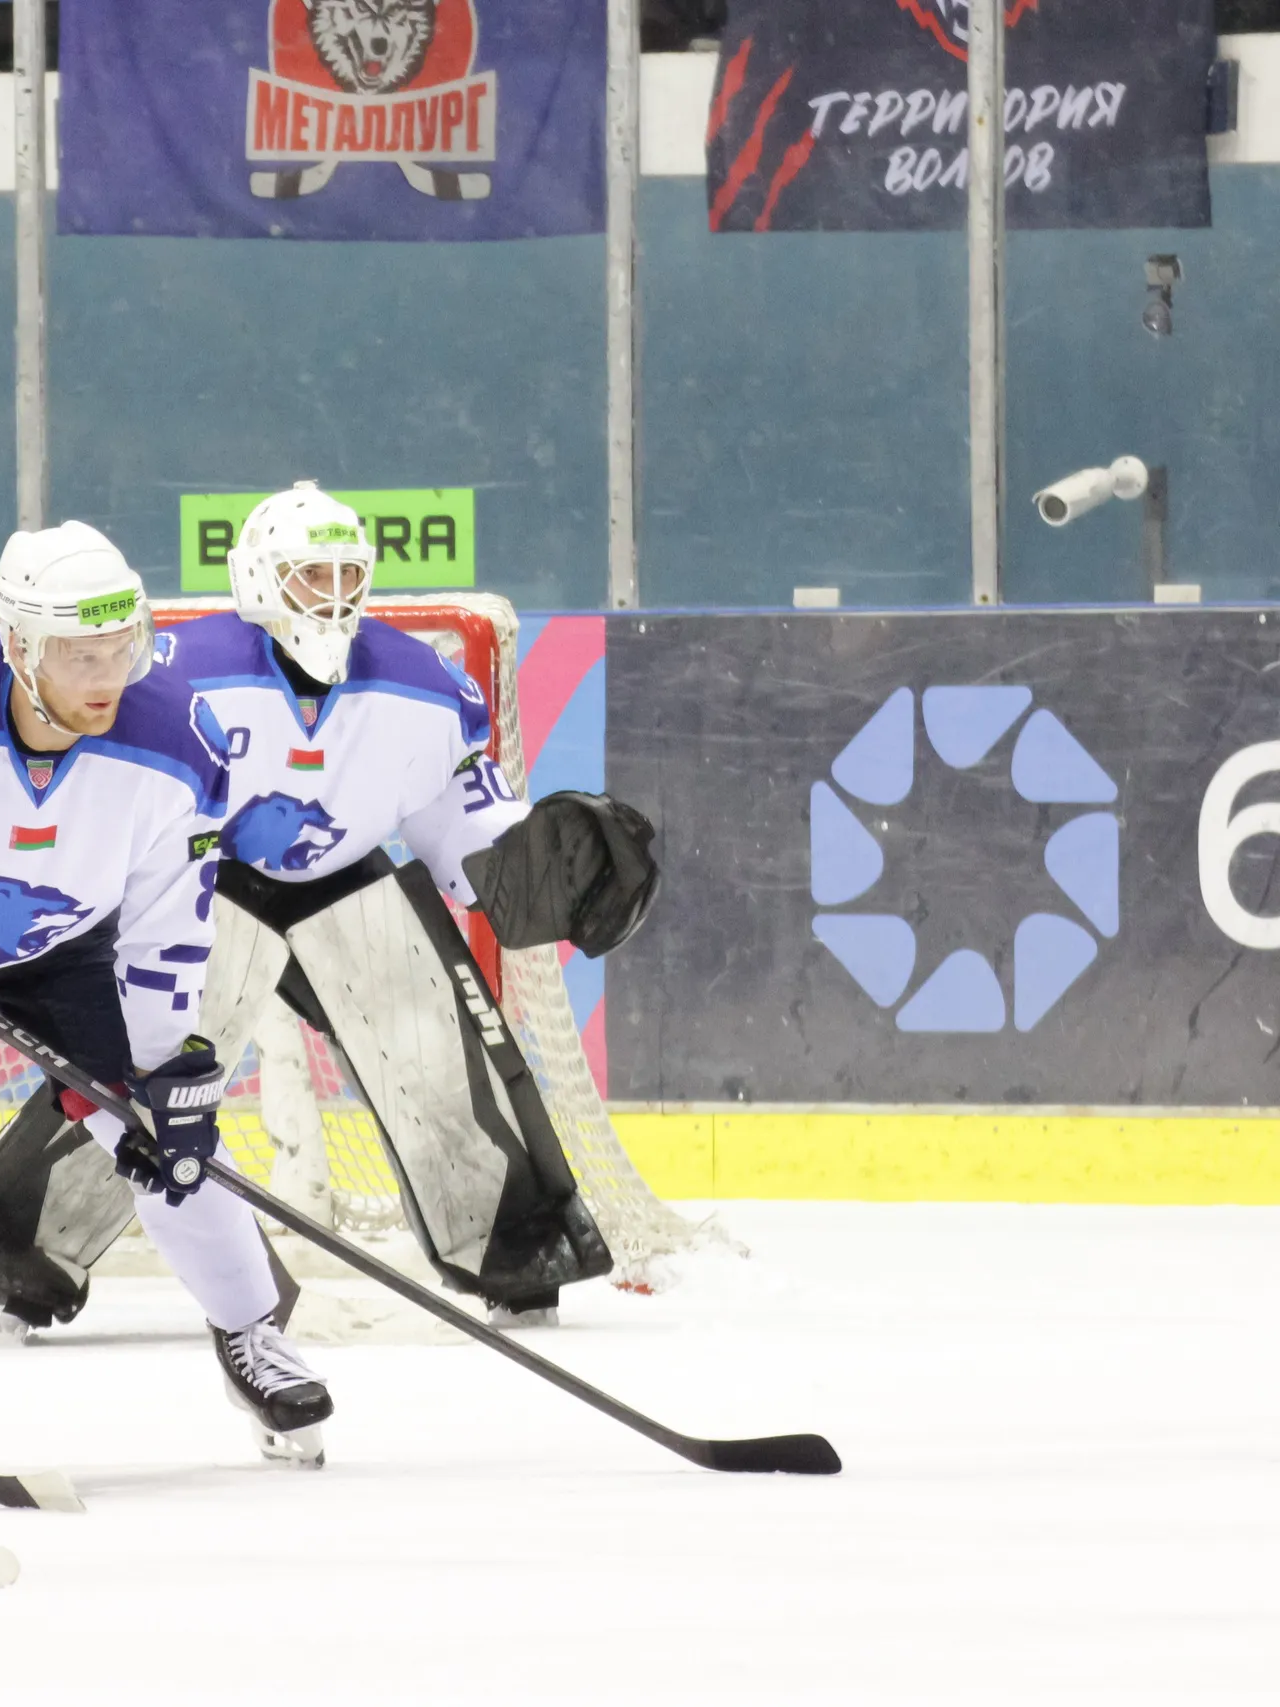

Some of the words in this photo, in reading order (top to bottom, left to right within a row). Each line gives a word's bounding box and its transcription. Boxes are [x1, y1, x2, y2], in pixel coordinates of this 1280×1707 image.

[253, 80, 488, 152] МЕТАЛЛУРГ
[808, 81, 1126, 138] ТЕРРИОРИЯ
[884, 141, 1055, 195] ВОЛОВ
[227, 726, 251, 759] 0
[462, 761, 521, 814] 30
